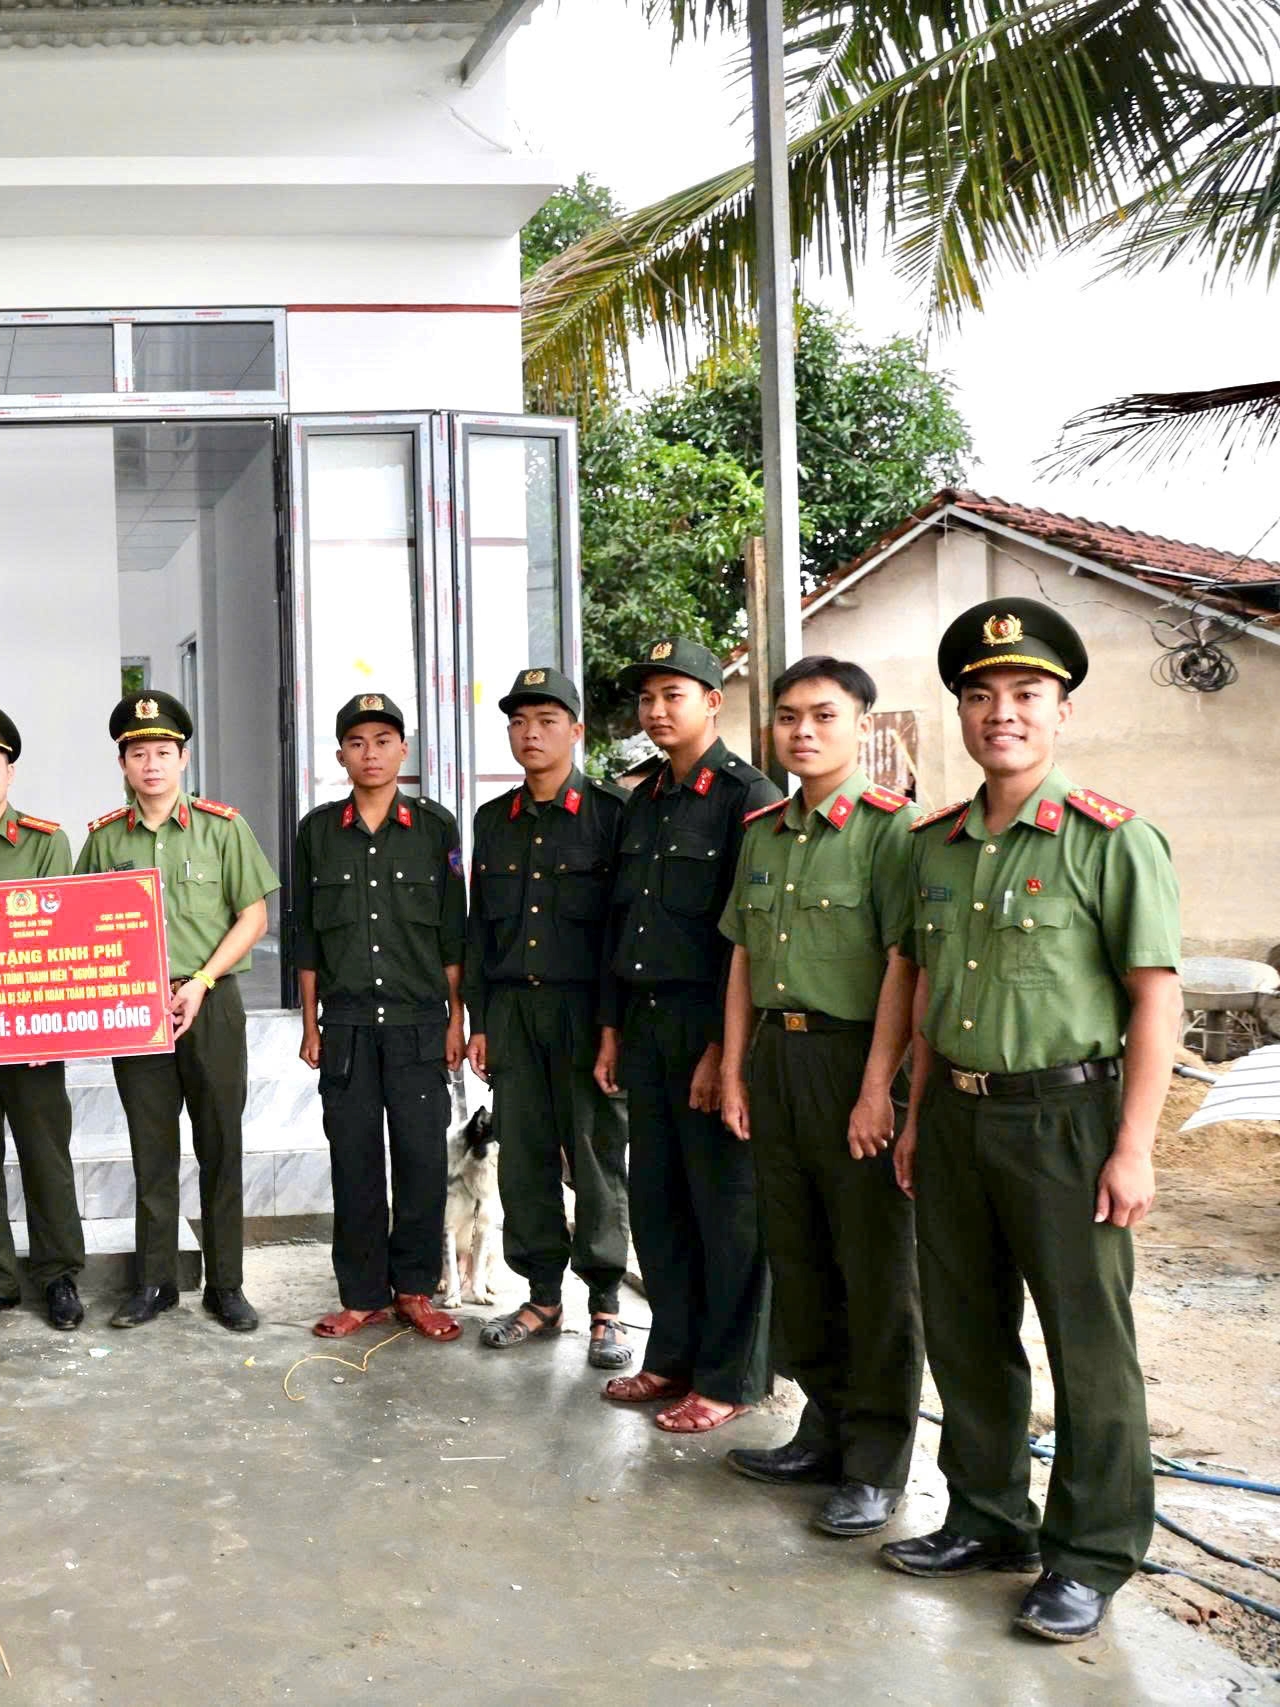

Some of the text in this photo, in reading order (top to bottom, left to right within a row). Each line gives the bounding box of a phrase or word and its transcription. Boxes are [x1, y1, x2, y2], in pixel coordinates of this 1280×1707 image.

[47, 946, 89, 962] KINH
[93, 940, 123, 959] PHÍ
[3, 970, 24, 985] TRÌNH
[25, 970, 49, 984] THANH
[98, 967, 116, 978] SINH
[7, 991, 16, 1006] BỊ
[44, 987, 65, 1002] HOÀN
[66, 986, 85, 1000] TOÀN
[86, 985, 97, 999] DO
[97, 983, 118, 998] THIÊN
[119, 984, 130, 996] TAI
[131, 980, 146, 995] GÂY
[146, 982, 157, 993] RA
[15, 1009, 99, 1036] 8.000.000
[102, 1000, 151, 1030] ĐỒNG
